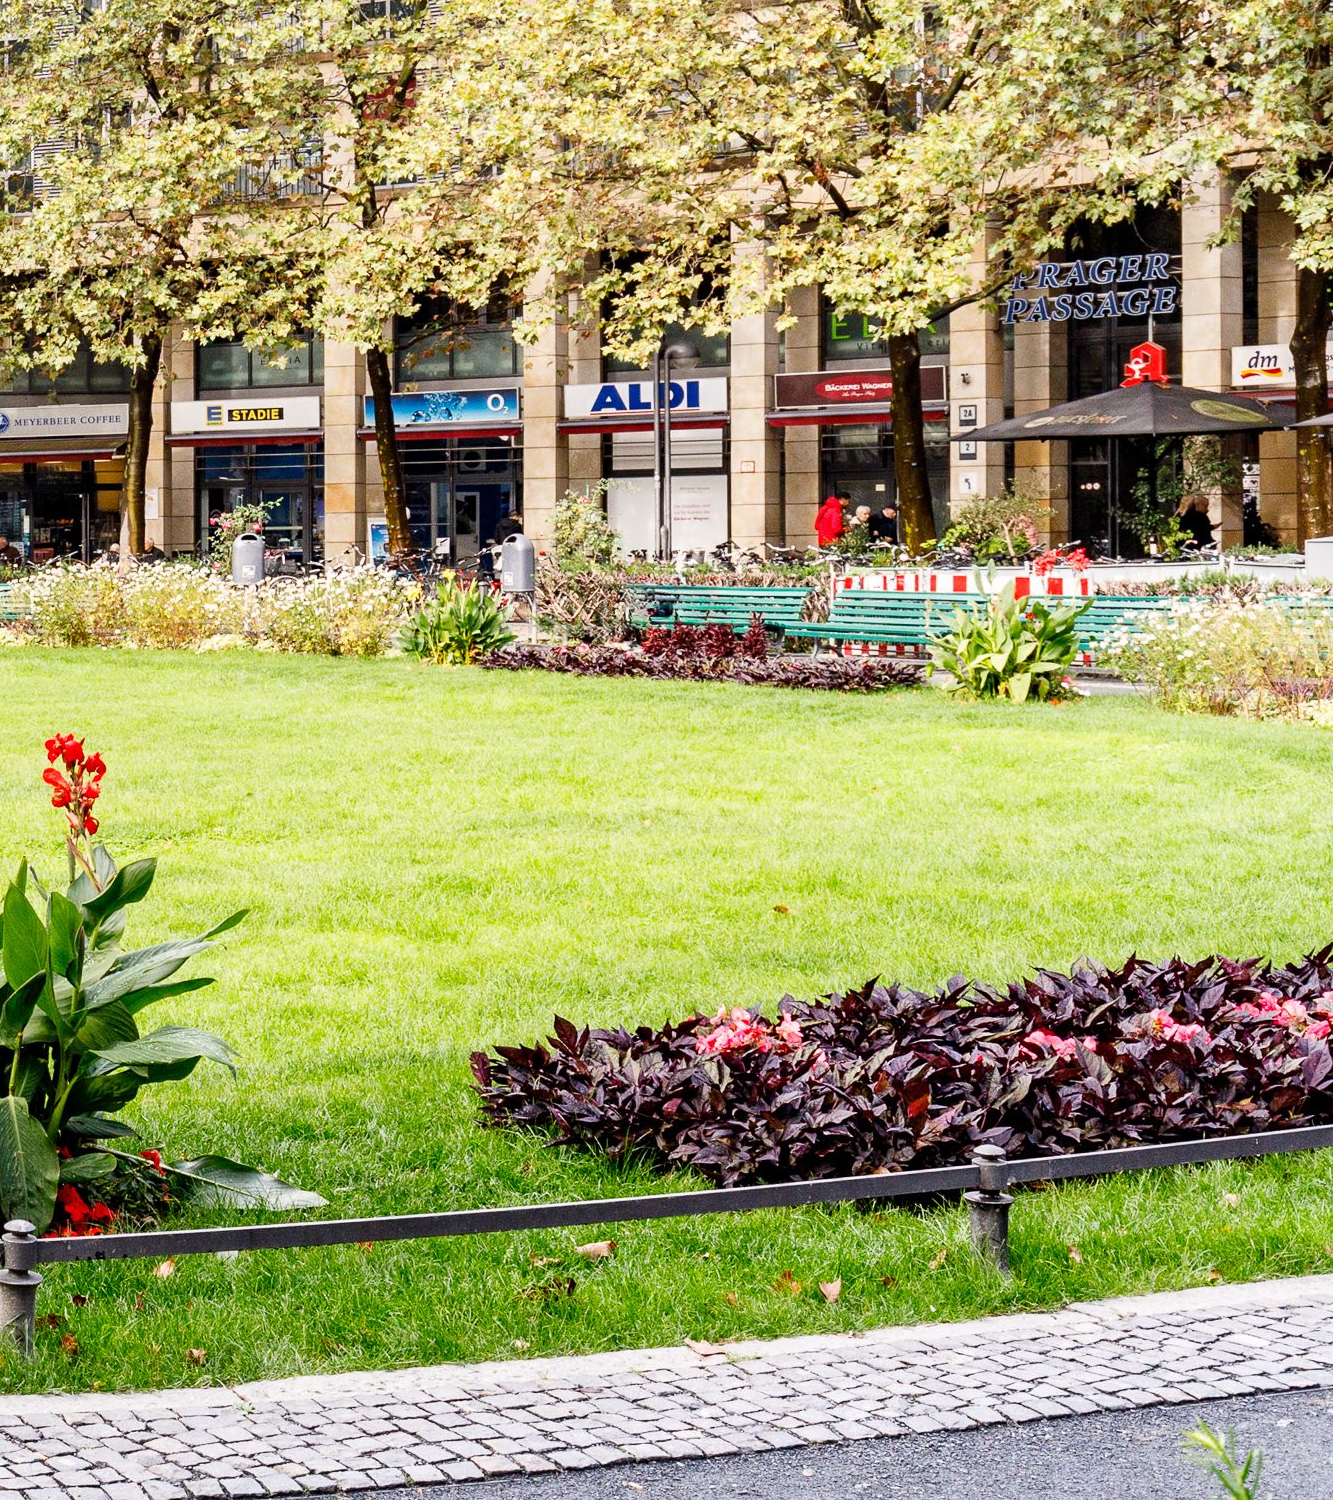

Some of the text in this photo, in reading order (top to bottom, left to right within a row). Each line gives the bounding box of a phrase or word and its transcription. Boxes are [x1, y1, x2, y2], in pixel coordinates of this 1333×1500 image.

[1011, 253, 1170, 291] PRAGER
[1002, 286, 1176, 324] PASSAGE
[1248, 351, 1278, 368] dm
[590, 381, 700, 412] ALDI
[232, 409, 279, 421] STADIE
[963, 409, 973, 417] 2A
[14, 415, 121, 427] MEYERBEER COFFEE
[965, 443, 970, 451] 2
